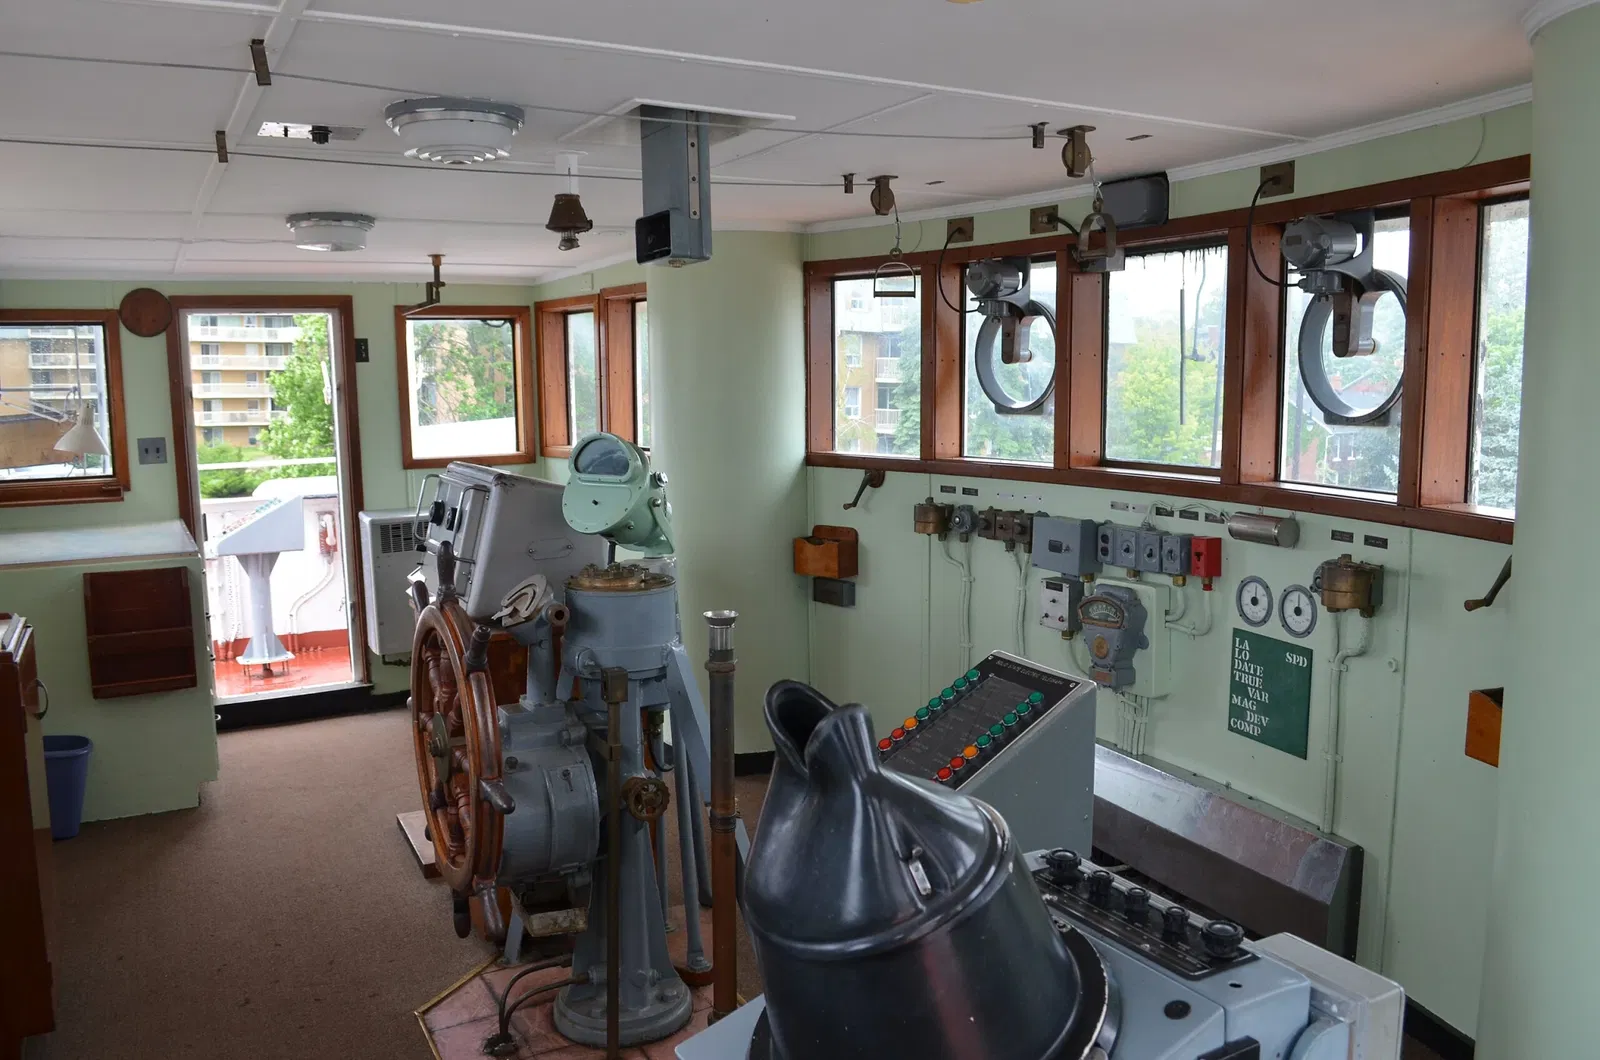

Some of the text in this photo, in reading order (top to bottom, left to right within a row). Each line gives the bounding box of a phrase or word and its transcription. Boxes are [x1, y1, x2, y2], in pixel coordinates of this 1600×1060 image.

[1235, 638, 1249, 650] LA
[1235, 648, 1249, 660] LO
[1286, 652, 1307, 667] SPD
[1234, 659, 1263, 676] DATE
[1233, 671, 1262, 688] TRUE
[1232, 694, 1256, 710] MAG
[1248, 687, 1269, 703] VAR
[1246, 711, 1269, 726] DEV
[1230, 718, 1261, 736] COMP
